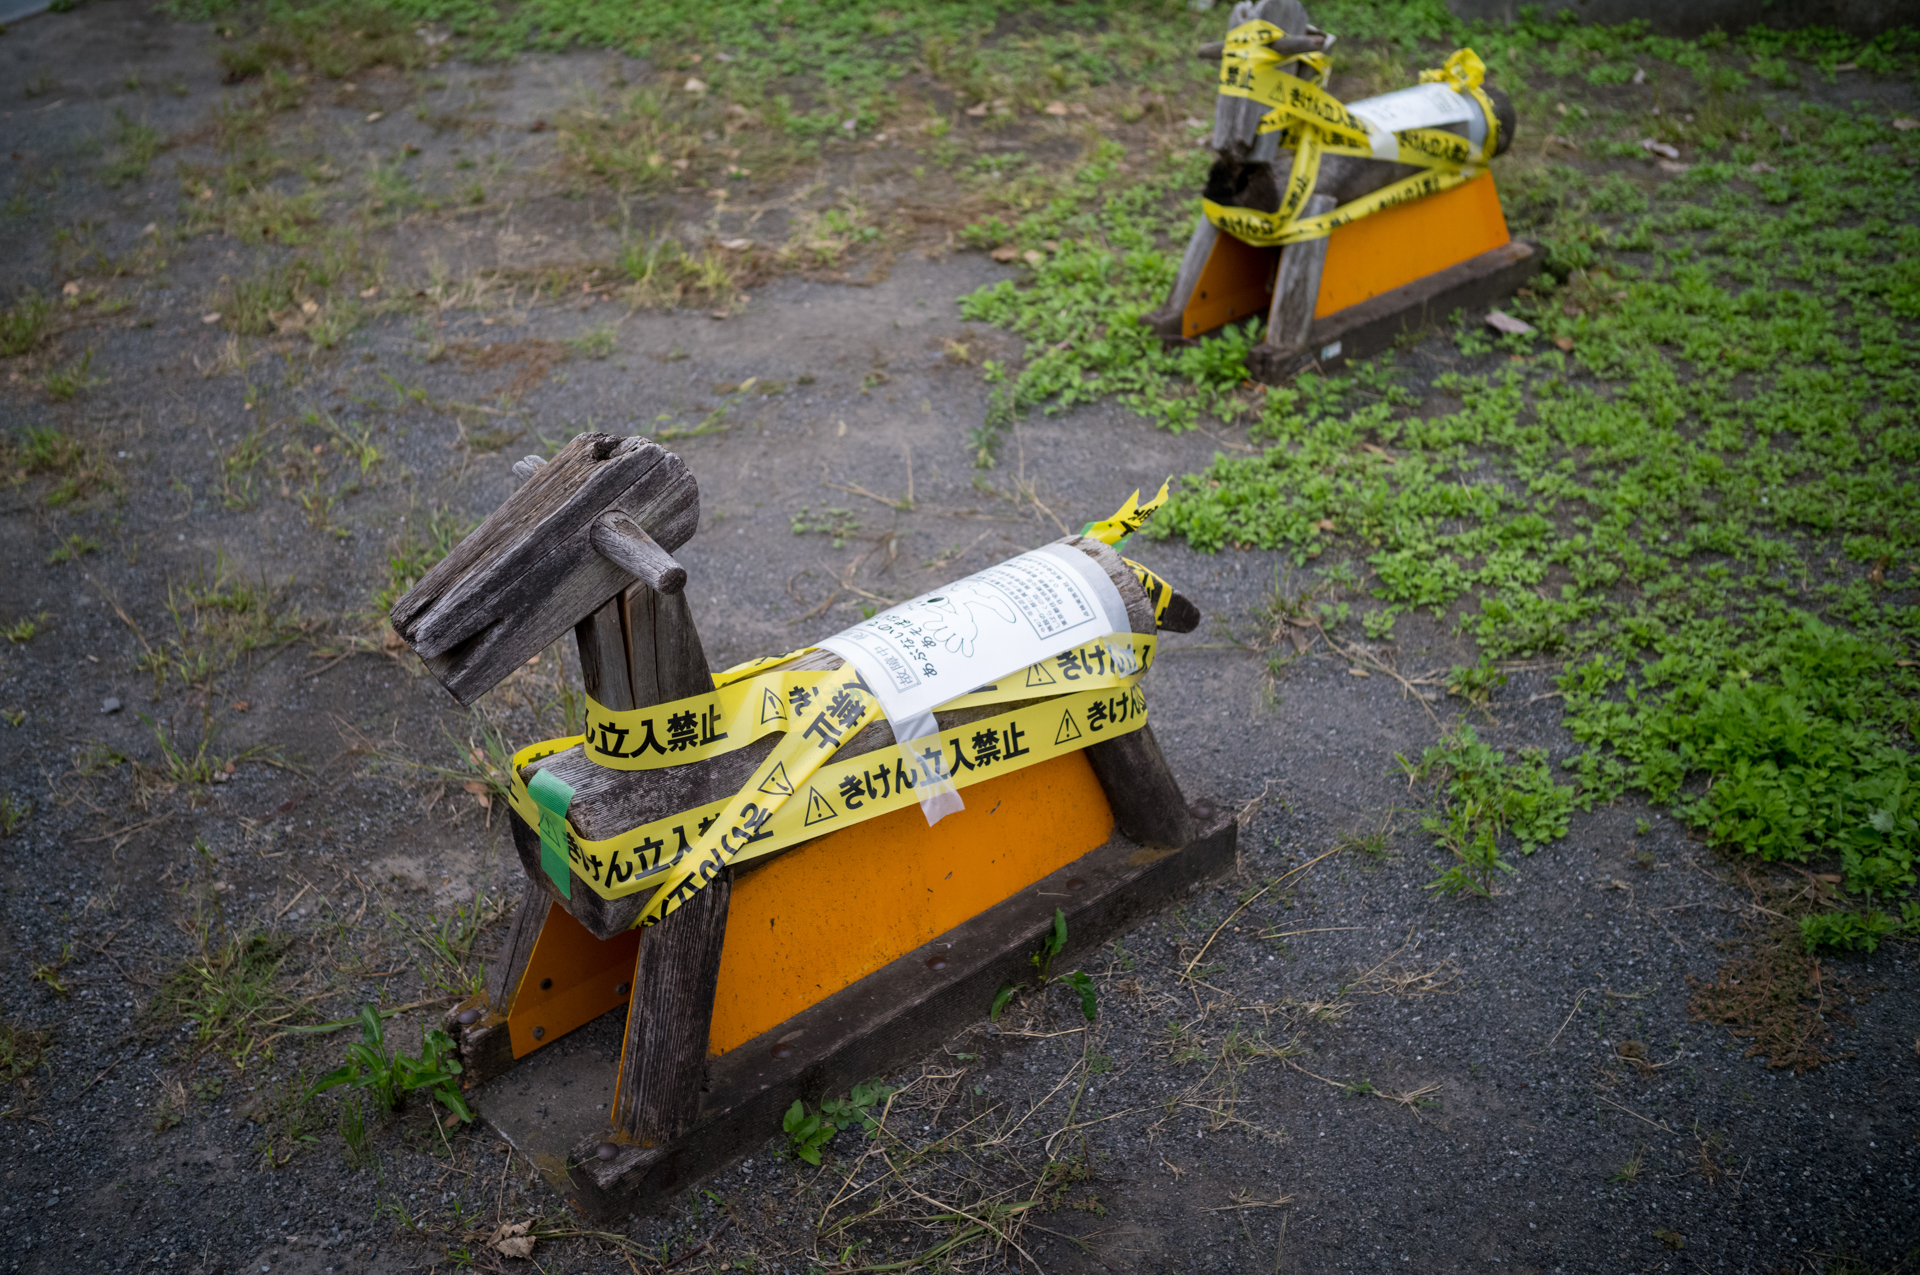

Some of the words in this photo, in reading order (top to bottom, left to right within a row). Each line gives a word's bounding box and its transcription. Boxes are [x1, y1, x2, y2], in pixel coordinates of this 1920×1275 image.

[873, 646, 914, 687] 故障中
[838, 721, 1030, 810] きけん立入禁止
